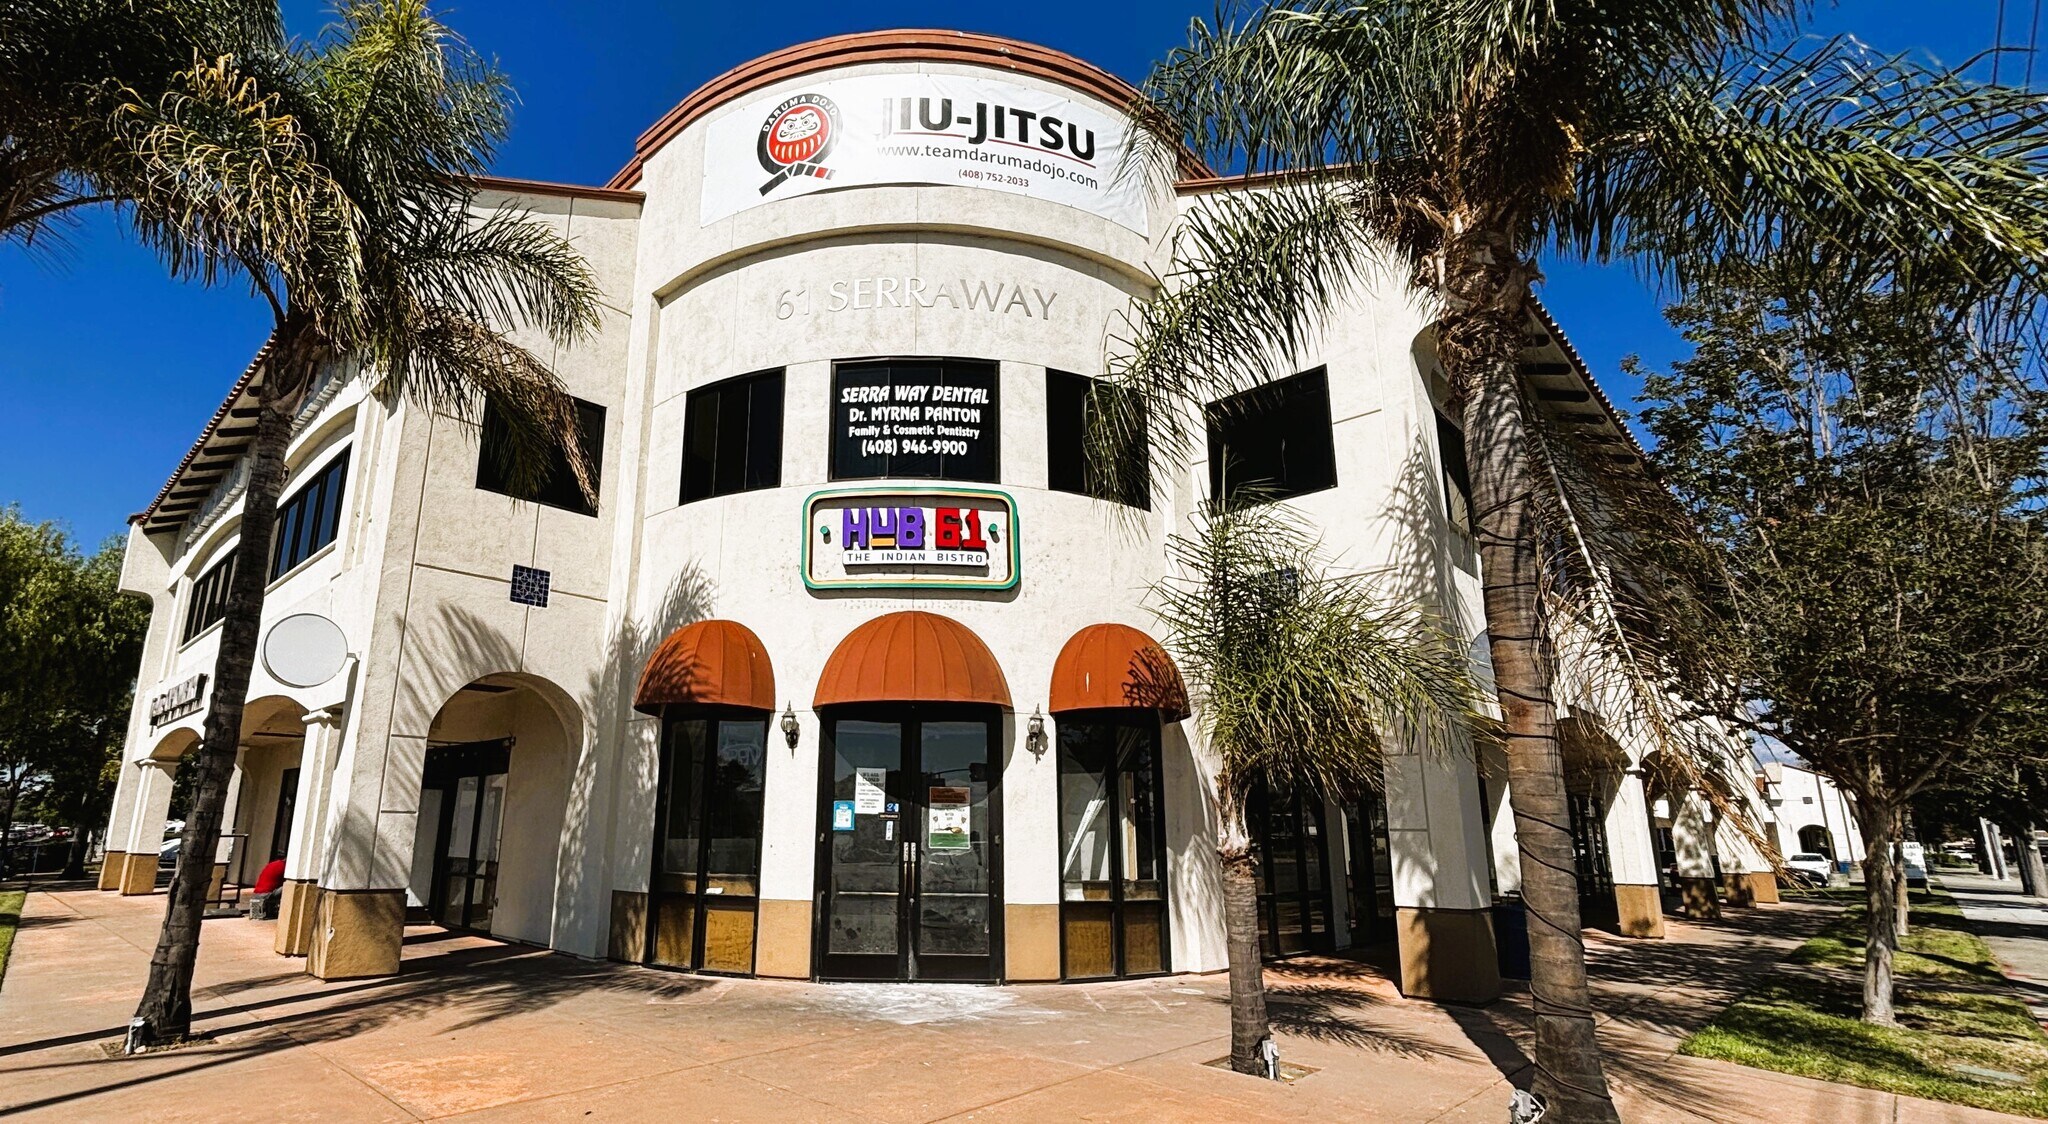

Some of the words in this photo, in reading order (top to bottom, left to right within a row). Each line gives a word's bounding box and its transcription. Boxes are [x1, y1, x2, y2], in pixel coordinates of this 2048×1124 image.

[762, 95, 806, 133] DARUMA
[812, 95, 838, 117] DOJO
[874, 97, 1095, 161] JIU-JITSU
[876, 144, 1098, 190] www.teamdarumadojo.com
[958, 169, 984, 181] (408)
[986, 172, 1030, 188] 752-2033
[775, 284, 812, 321] 61
[841, 386, 891, 404] SERRA
[894, 385, 930, 402] WAY
[932, 386, 990, 404] DENTAL
[849, 408, 867, 422] Dr.
[871, 406, 920, 422] MYRNA
[925, 406, 981, 423] PANTON
[849, 425, 880, 438] Family
[883, 424, 891, 435] &
[893, 424, 934, 436] Cosmetic
[937, 425, 980, 440] Dentistry
[861, 438, 897, 457] (408)
[902, 439, 967, 456] 946-9900
[842, 507, 924, 548] HUB
[935, 507, 987, 549] 61
[847, 553, 870, 561] THE
[882, 552, 926, 561] INDIAN
[937, 553, 983, 563] BISTRO
